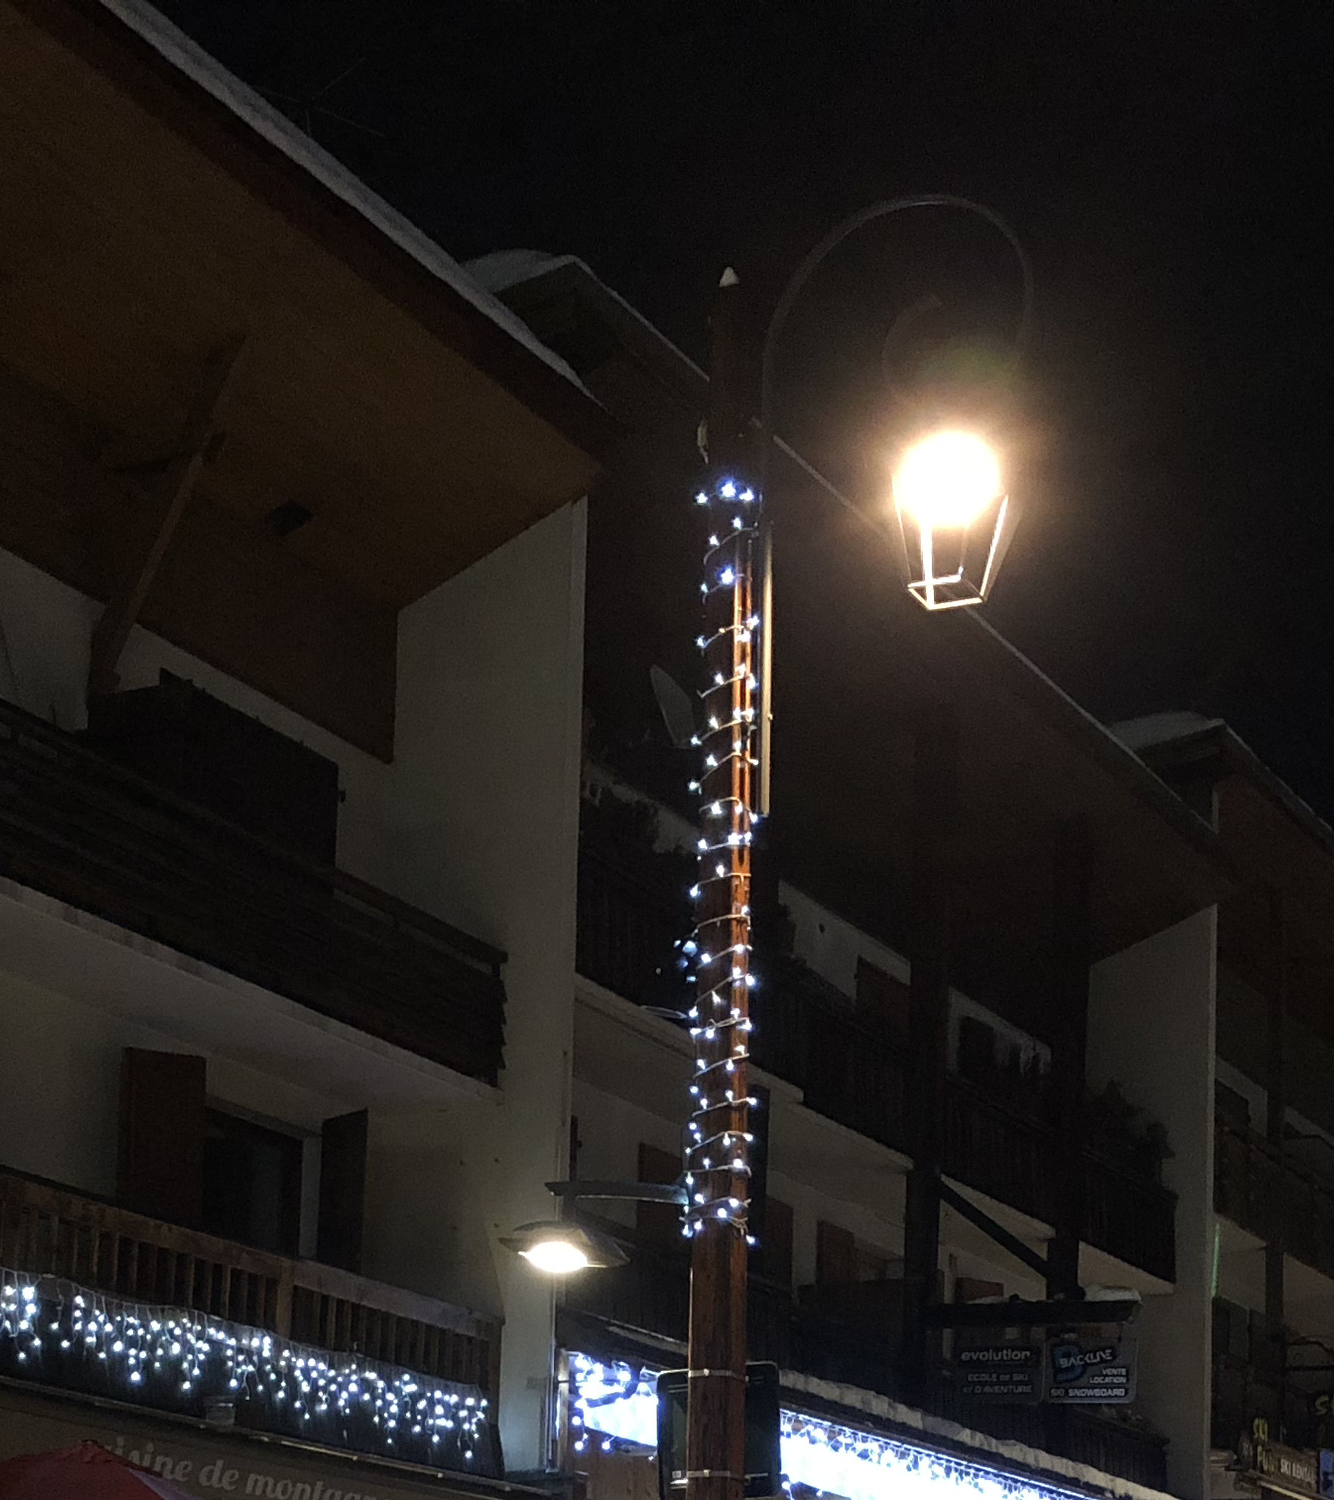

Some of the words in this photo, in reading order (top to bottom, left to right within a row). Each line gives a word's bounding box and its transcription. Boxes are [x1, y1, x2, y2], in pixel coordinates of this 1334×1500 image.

[1089, 1376, 1127, 1384] LOCATION
[1067, 1388, 1126, 1397] SNOWBOARD
[104, 1436, 193, 1482] isine
[198, 1458, 240, 1492] de
